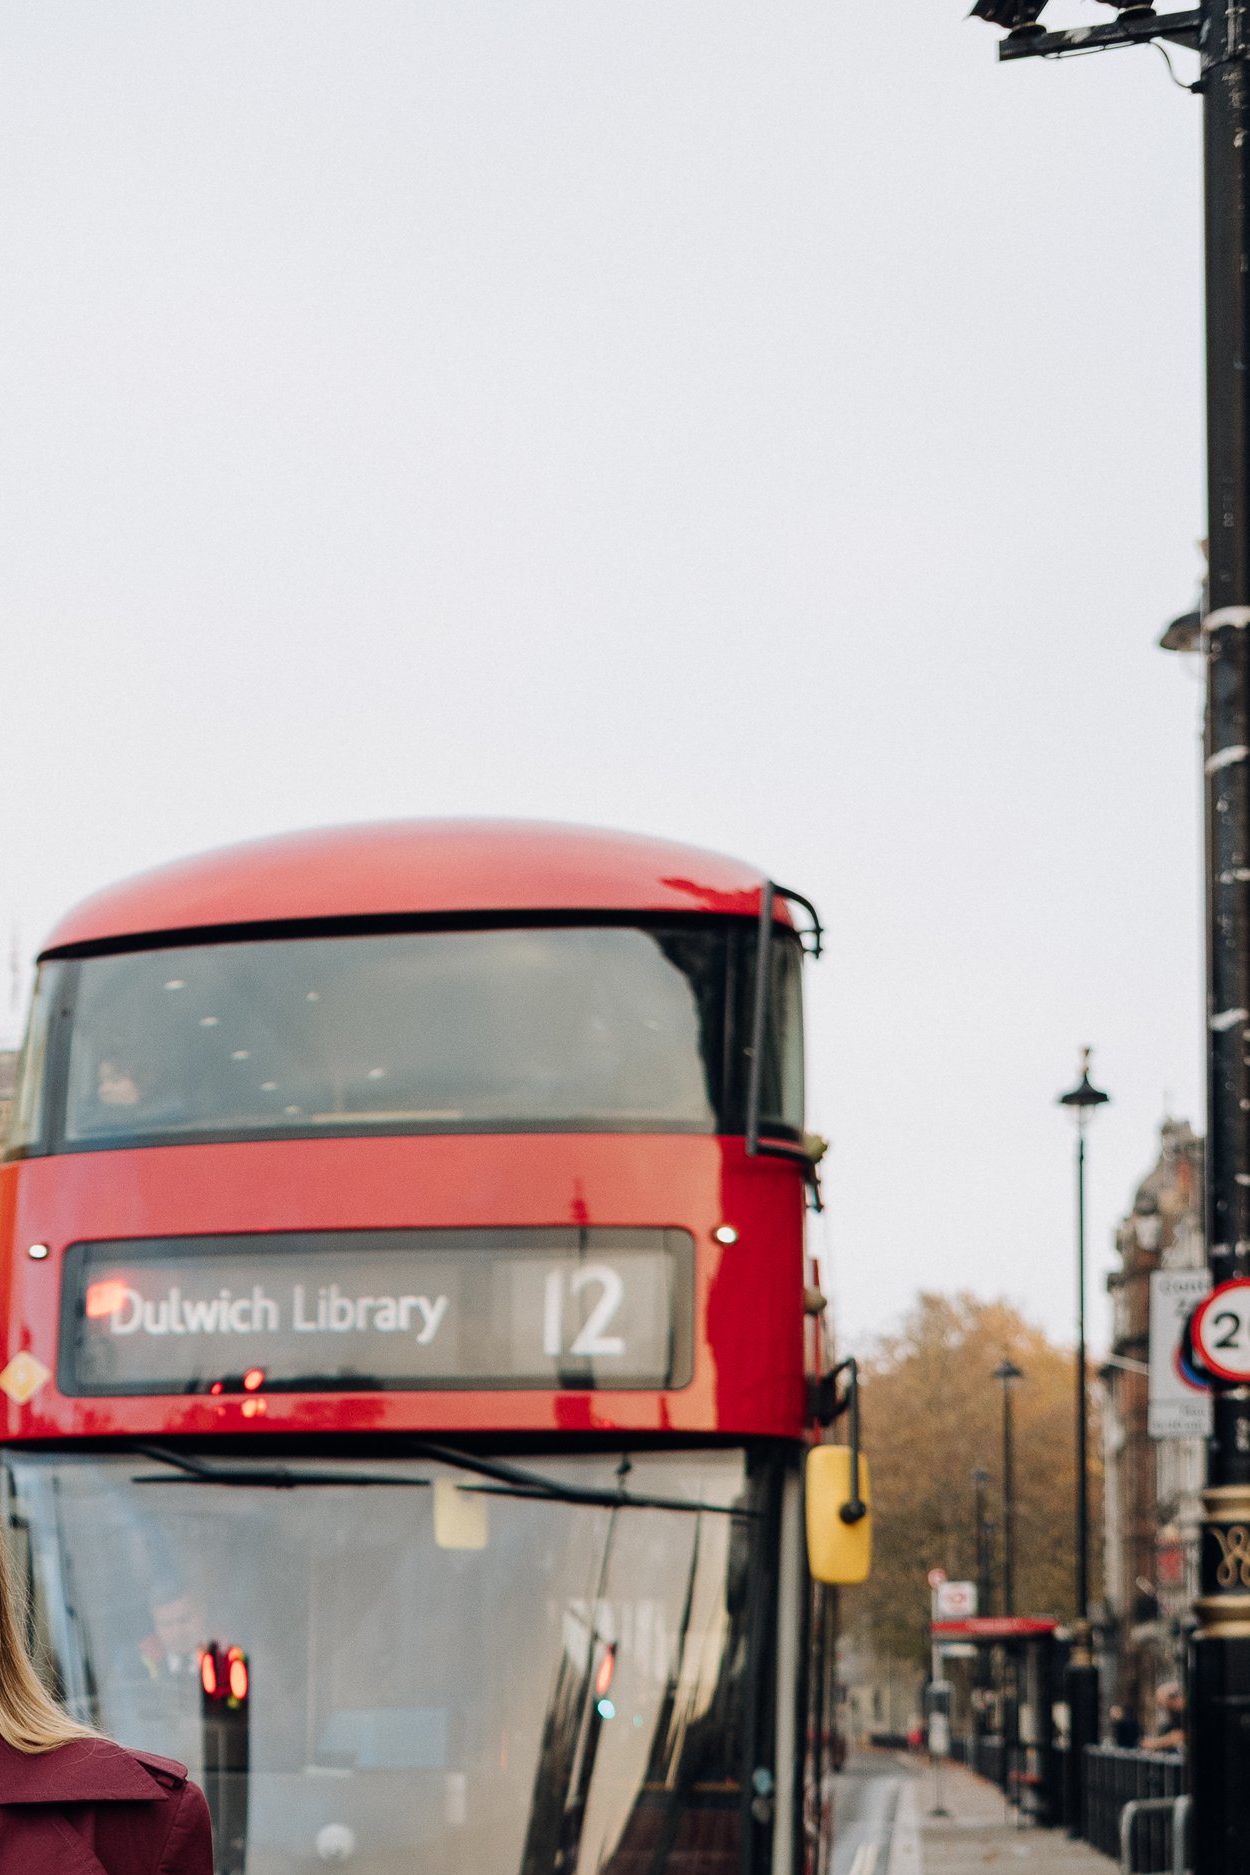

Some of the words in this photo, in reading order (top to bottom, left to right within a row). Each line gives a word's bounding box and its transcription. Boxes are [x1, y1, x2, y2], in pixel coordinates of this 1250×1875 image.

[110, 1285, 279, 1335] Dulwich
[293, 1284, 448, 1344] Library
[542, 1264, 626, 1356] 12
[1213, 1312, 1250, 1348] 2
